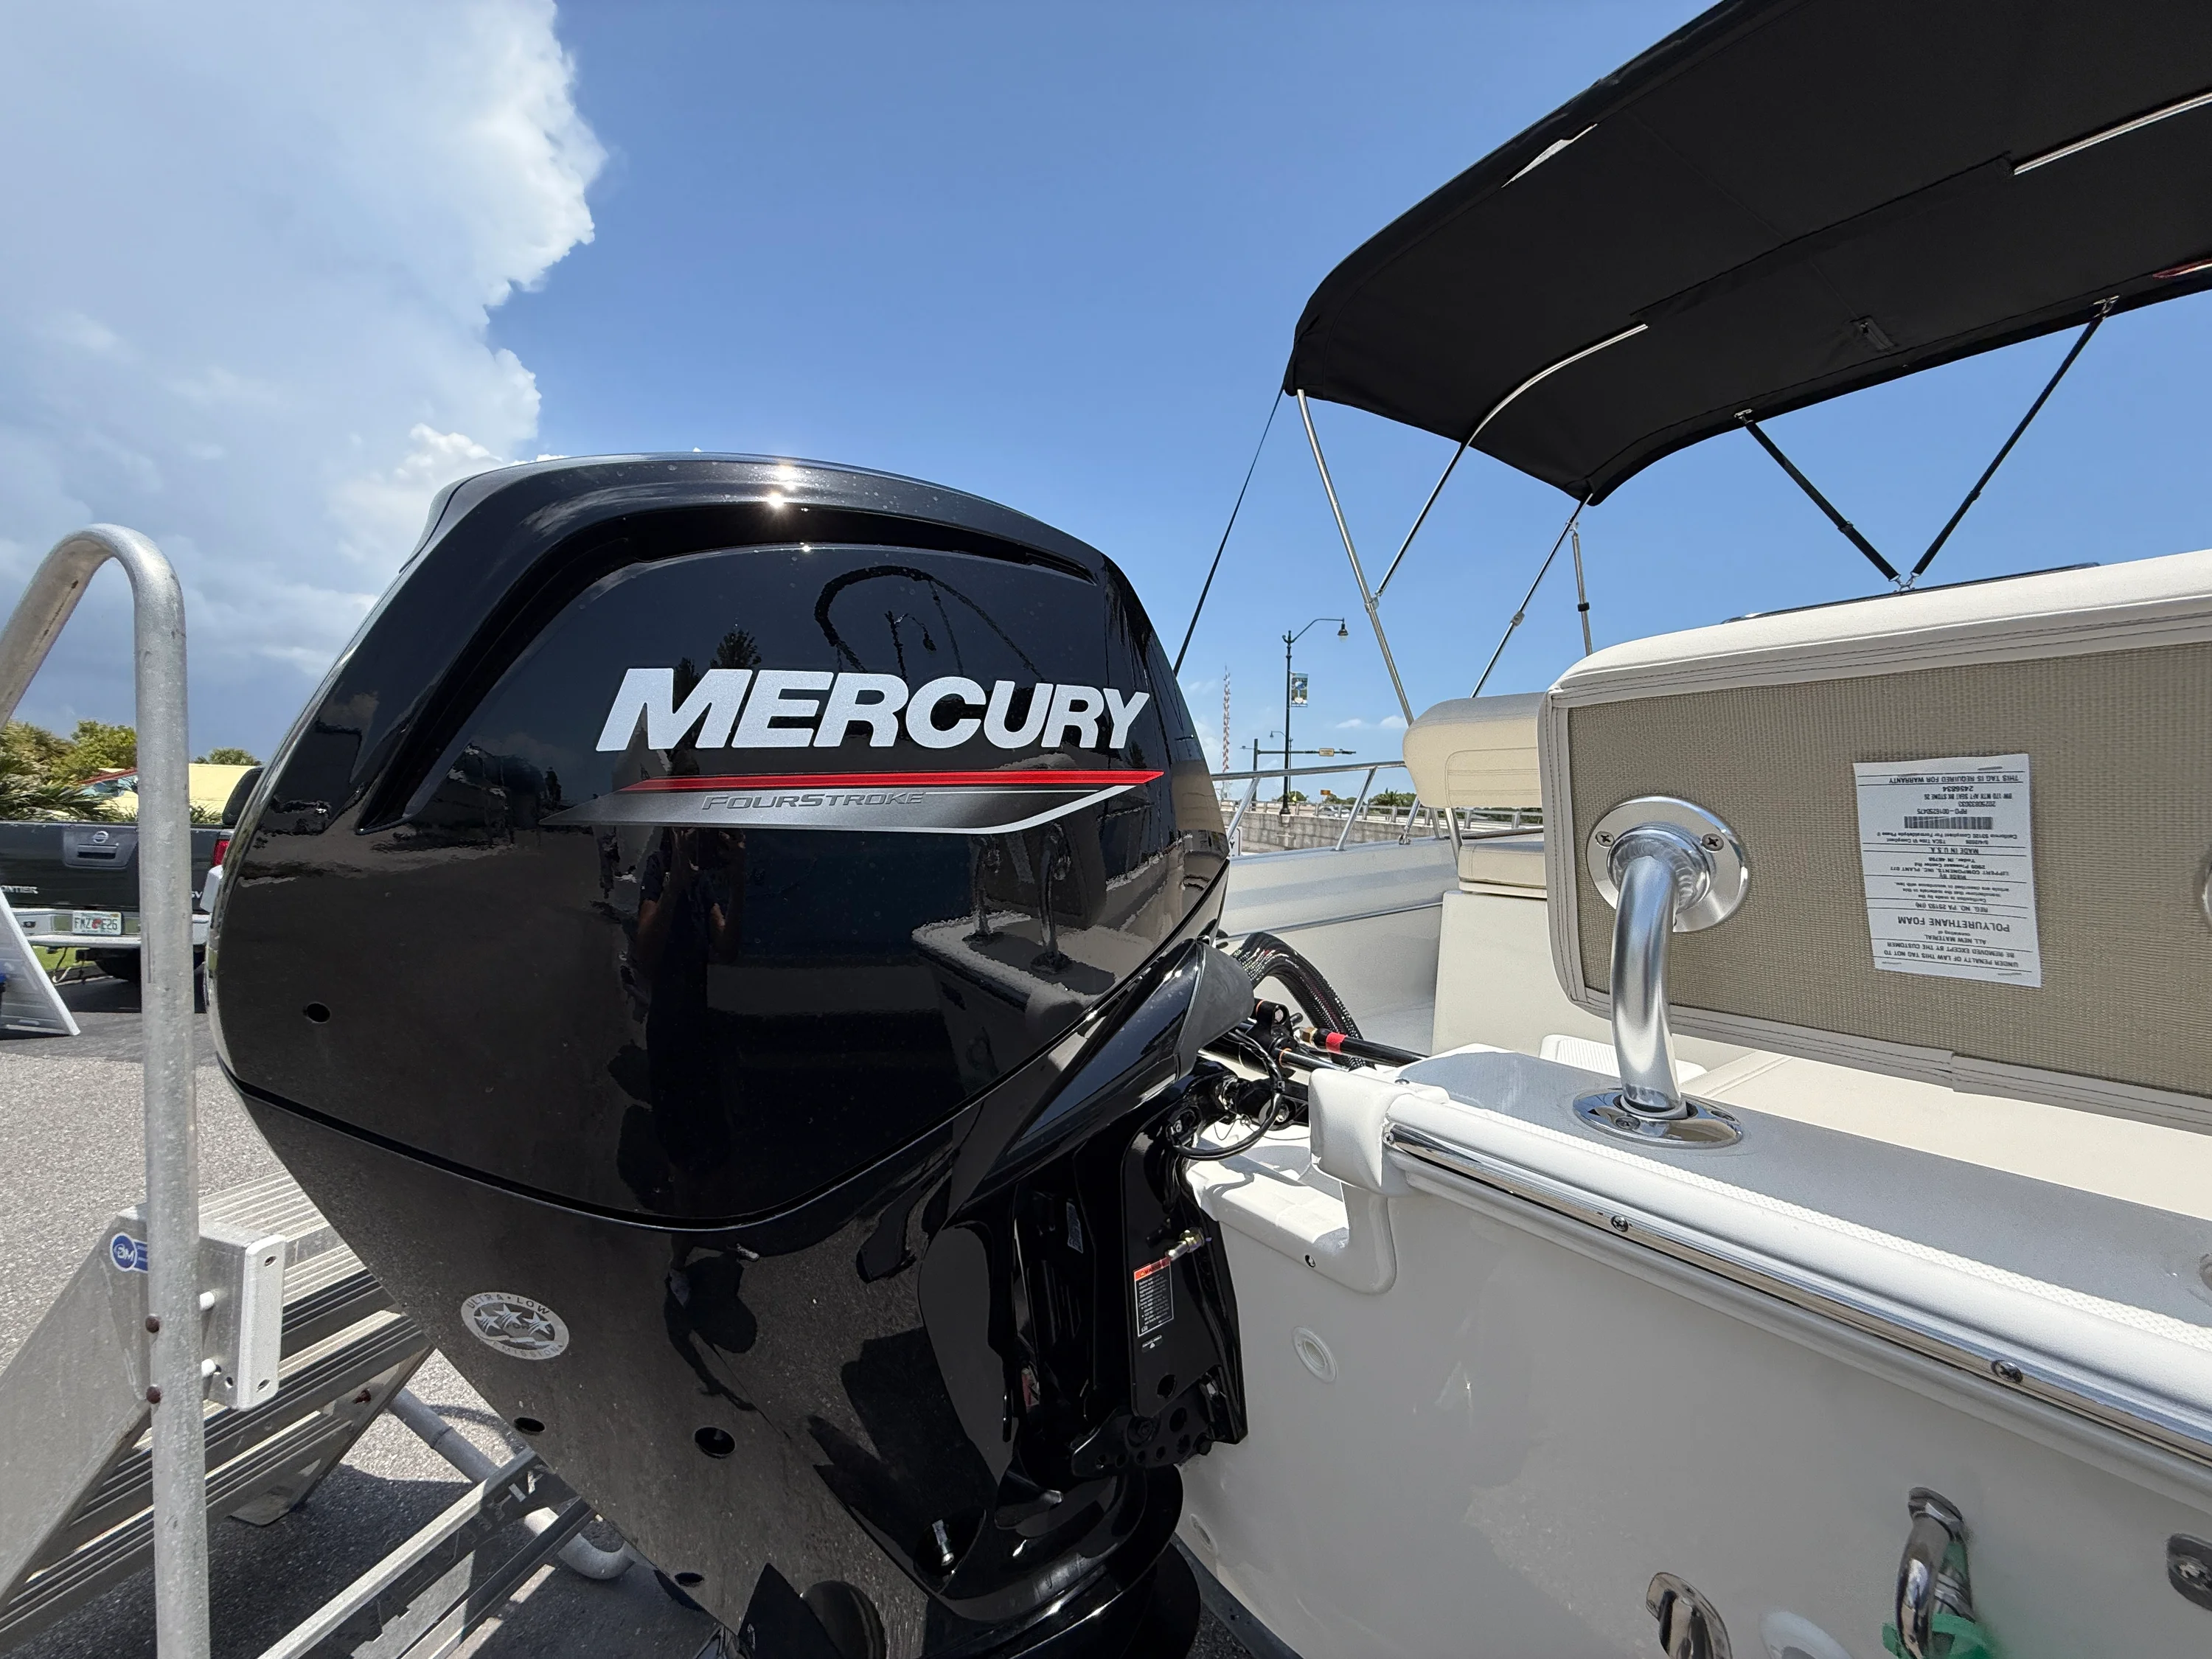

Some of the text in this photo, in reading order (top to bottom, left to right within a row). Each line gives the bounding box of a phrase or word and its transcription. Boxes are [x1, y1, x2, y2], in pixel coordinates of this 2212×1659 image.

[596, 668, 1150, 751] MERCURY
[702, 793, 925, 810] FOURSTROKE
[1898, 917, 2009, 932] POLYURETHANE FOAM
[1964, 956, 1992, 965] PENALTY
[1972, 949, 2003, 957] REMOVED
[466, 1293, 550, 1315] ULTRA LOW
